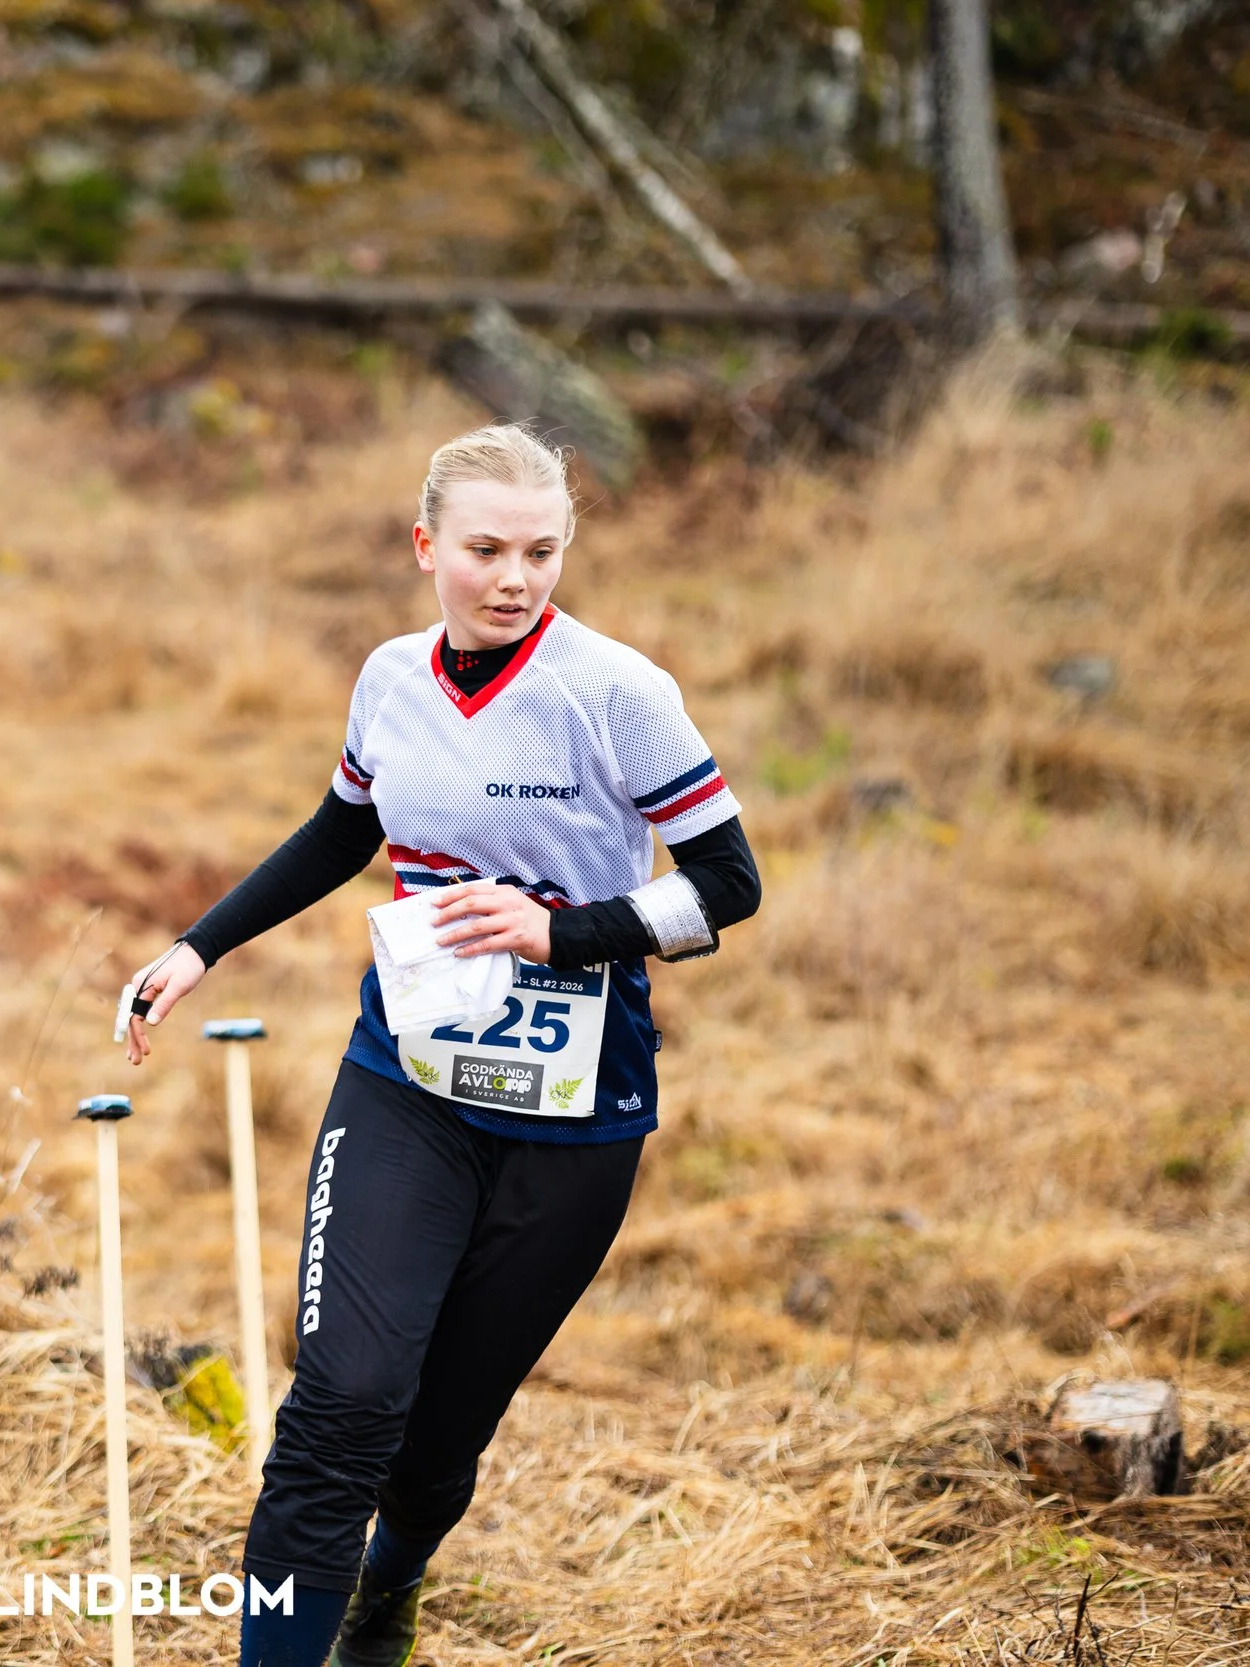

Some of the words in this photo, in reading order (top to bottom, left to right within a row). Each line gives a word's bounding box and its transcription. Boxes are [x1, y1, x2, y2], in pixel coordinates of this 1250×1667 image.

[486, 783, 514, 798] OK
[519, 784, 580, 800] ROXEN
[530, 978, 541, 987] SL
[543, 979, 557, 989] #2
[560, 981, 584, 992] 2026
[460, 1062, 534, 1081] GODKÄNDA
[473, 1090, 510, 1100] SVERIGE
[303, 1127, 346, 1336] bagheera
